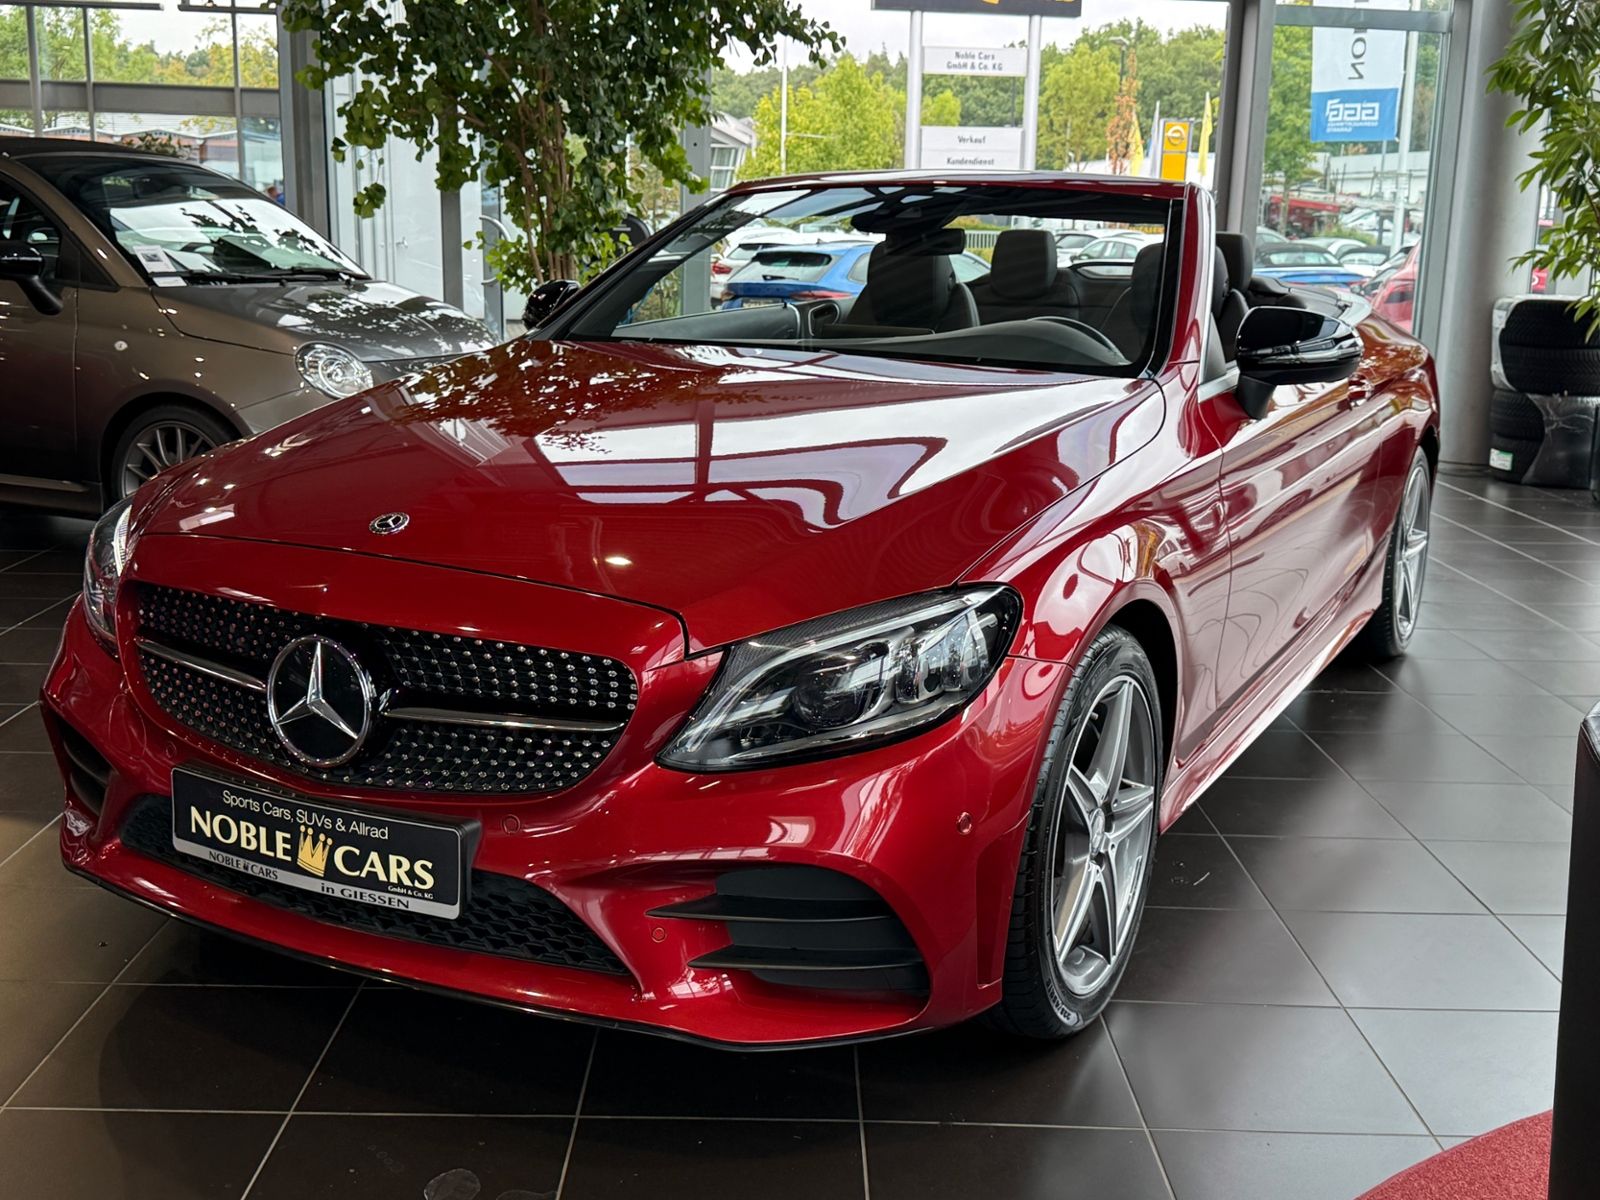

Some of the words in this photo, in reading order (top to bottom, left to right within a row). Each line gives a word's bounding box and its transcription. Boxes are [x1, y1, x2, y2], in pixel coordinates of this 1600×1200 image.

[978, 51, 996, 60] Cars
[946, 61, 968, 70] GmbH
[970, 62, 976, 70] &
[992, 63, 1004, 72] KG
[957, 135, 986, 144] Verkauf
[946, 157, 995, 166] Kundendienst
[222, 790, 260, 812] Sports
[262, 801, 294, 822] Cars,
[296, 809, 332, 830] SUVs
[335, 817, 346, 832] &
[349, 820, 388, 840] Allrad
[190, 805, 292, 862] NOBLE
[333, 845, 435, 890] CARS
[208, 850, 241, 869] NOBLE
[250, 864, 278, 881] CARS
[320, 882, 335, 895] in
[340, 887, 409, 909] GIESSEN
[387, 884, 408, 895] GmbH
[424, 892, 434, 900] KG
